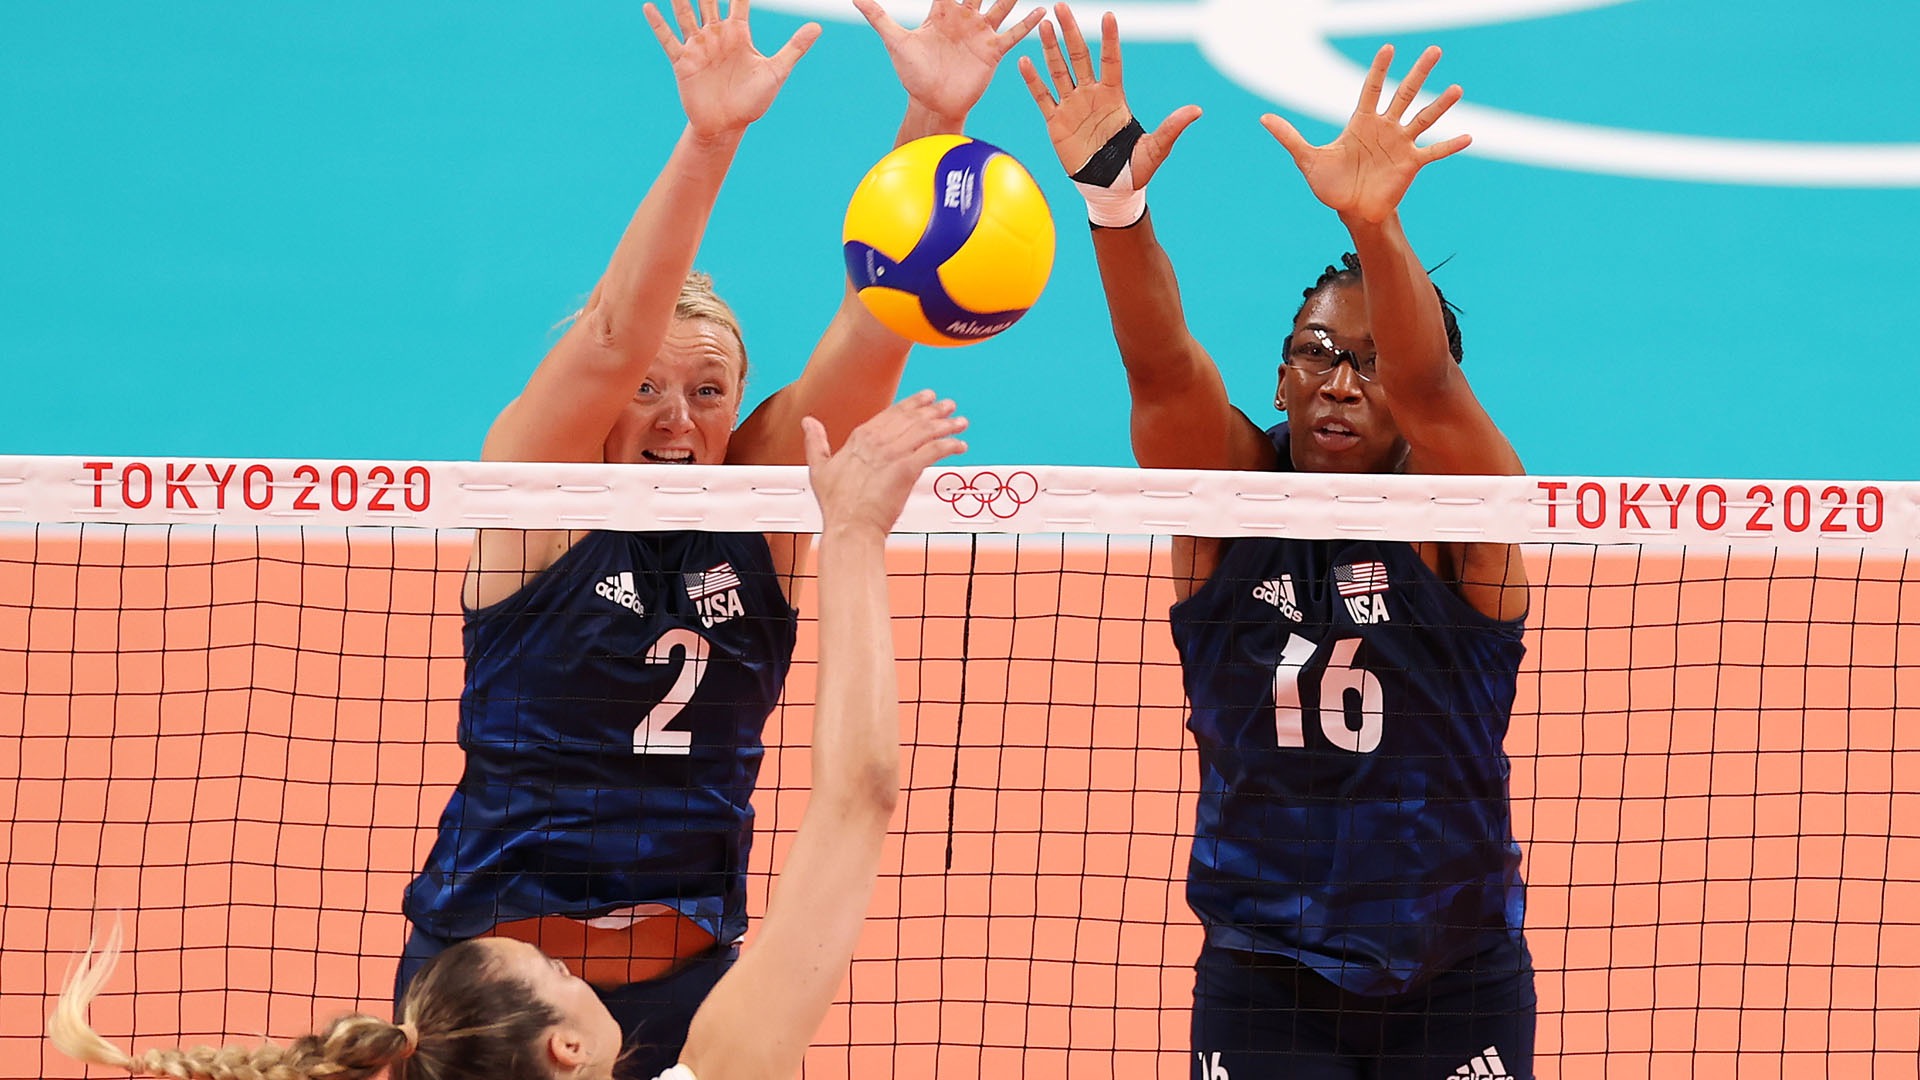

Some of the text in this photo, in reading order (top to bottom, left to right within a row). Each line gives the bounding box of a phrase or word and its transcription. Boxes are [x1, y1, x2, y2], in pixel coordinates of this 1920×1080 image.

[83, 462, 431, 512] TOKYO 2020
[1537, 482, 1884, 532] TOKYO 2020
[595, 579, 646, 618] adidas
[695, 588, 745, 629] USA
[1252, 584, 1304, 623] adidas
[1344, 593, 1390, 625] USA
[633, 627, 711, 755] 2
[1272, 632, 1384, 754] 16
